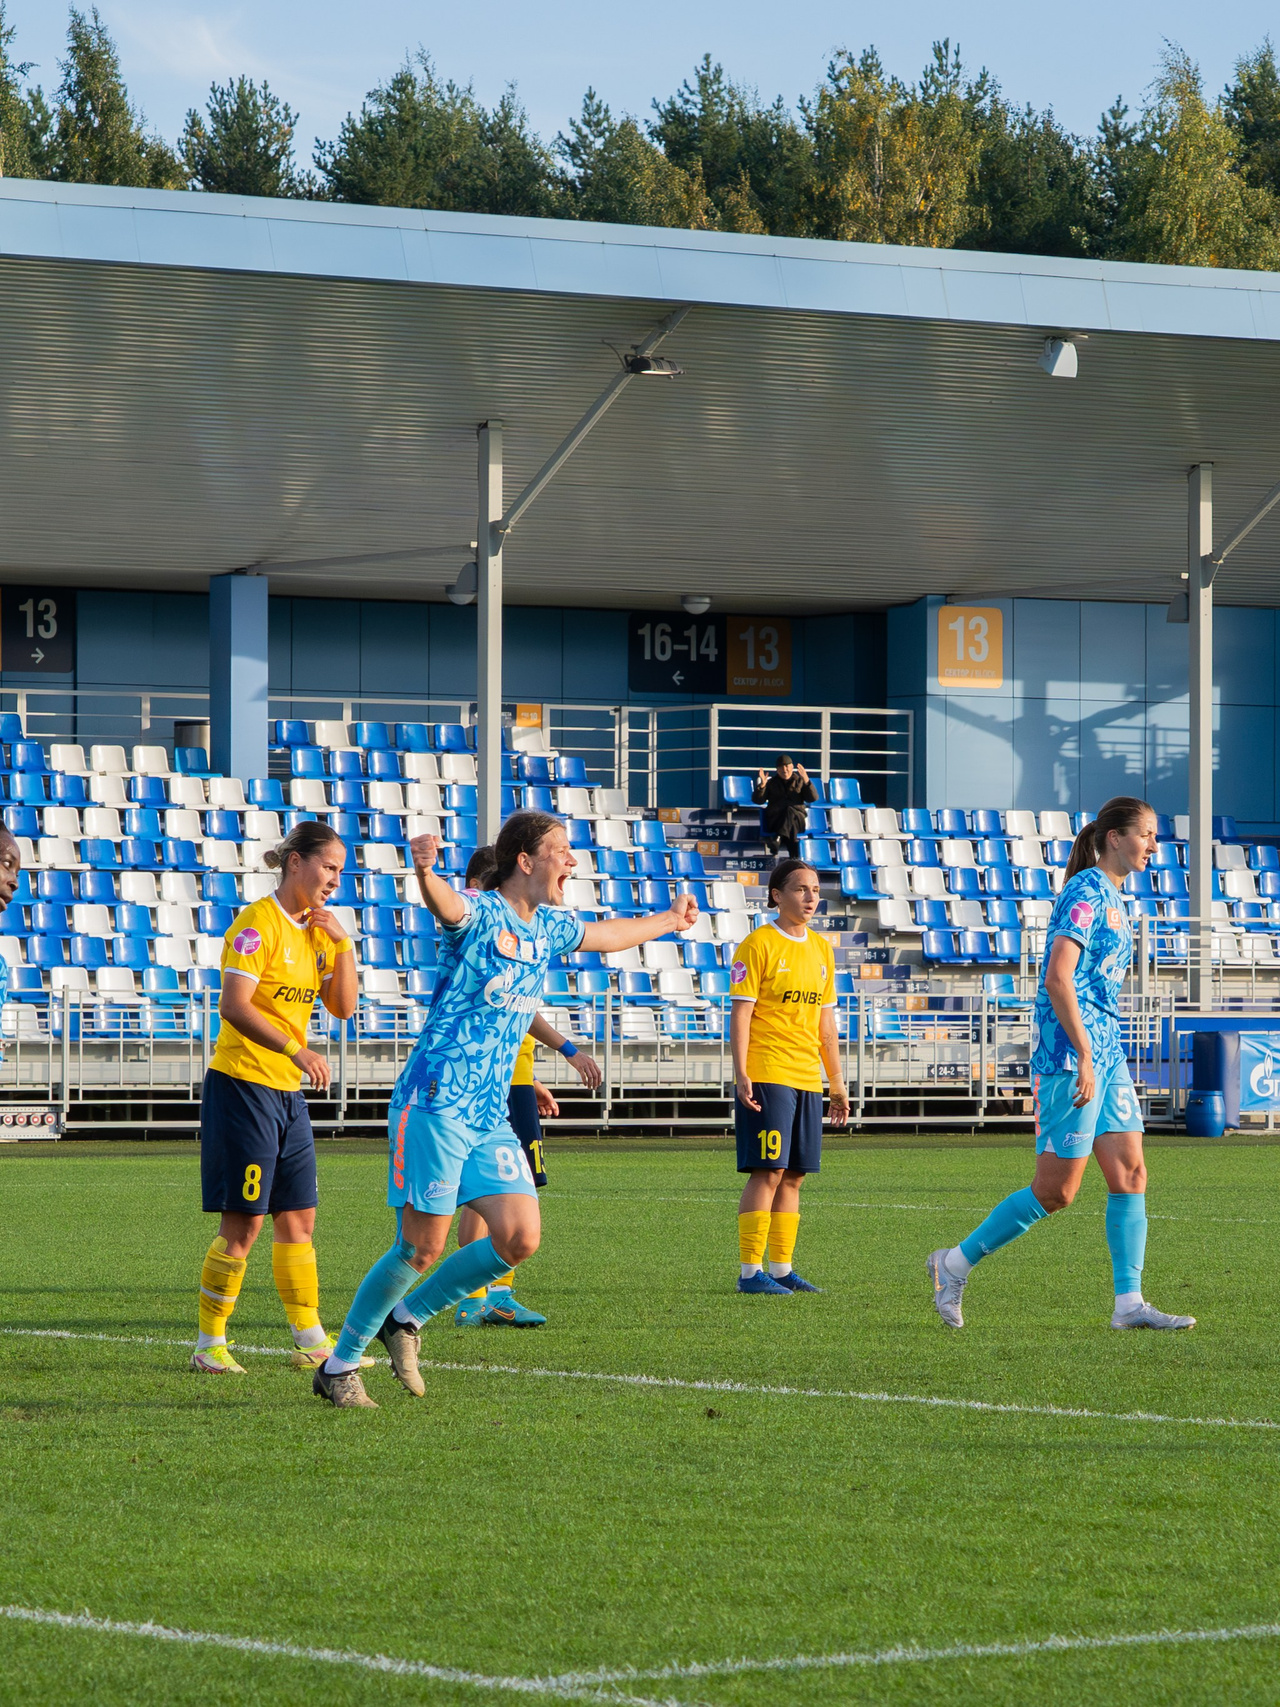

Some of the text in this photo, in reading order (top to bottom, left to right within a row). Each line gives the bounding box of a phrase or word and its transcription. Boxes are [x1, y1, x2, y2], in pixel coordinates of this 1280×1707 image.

[19, 598, 58, 639] 13
[637, 622, 719, 662] 16-14
[739, 625, 780, 671] 13
[948, 615, 990, 662] 13
[751, 876, 756, 884] 7
[920, 998, 926, 1008] 3
[938, 1066, 955, 1075] 24-2
[757, 1129, 782, 1160] 19
[242, 1163, 263, 1202] 8
[494, 1146, 535, 1186] 88
